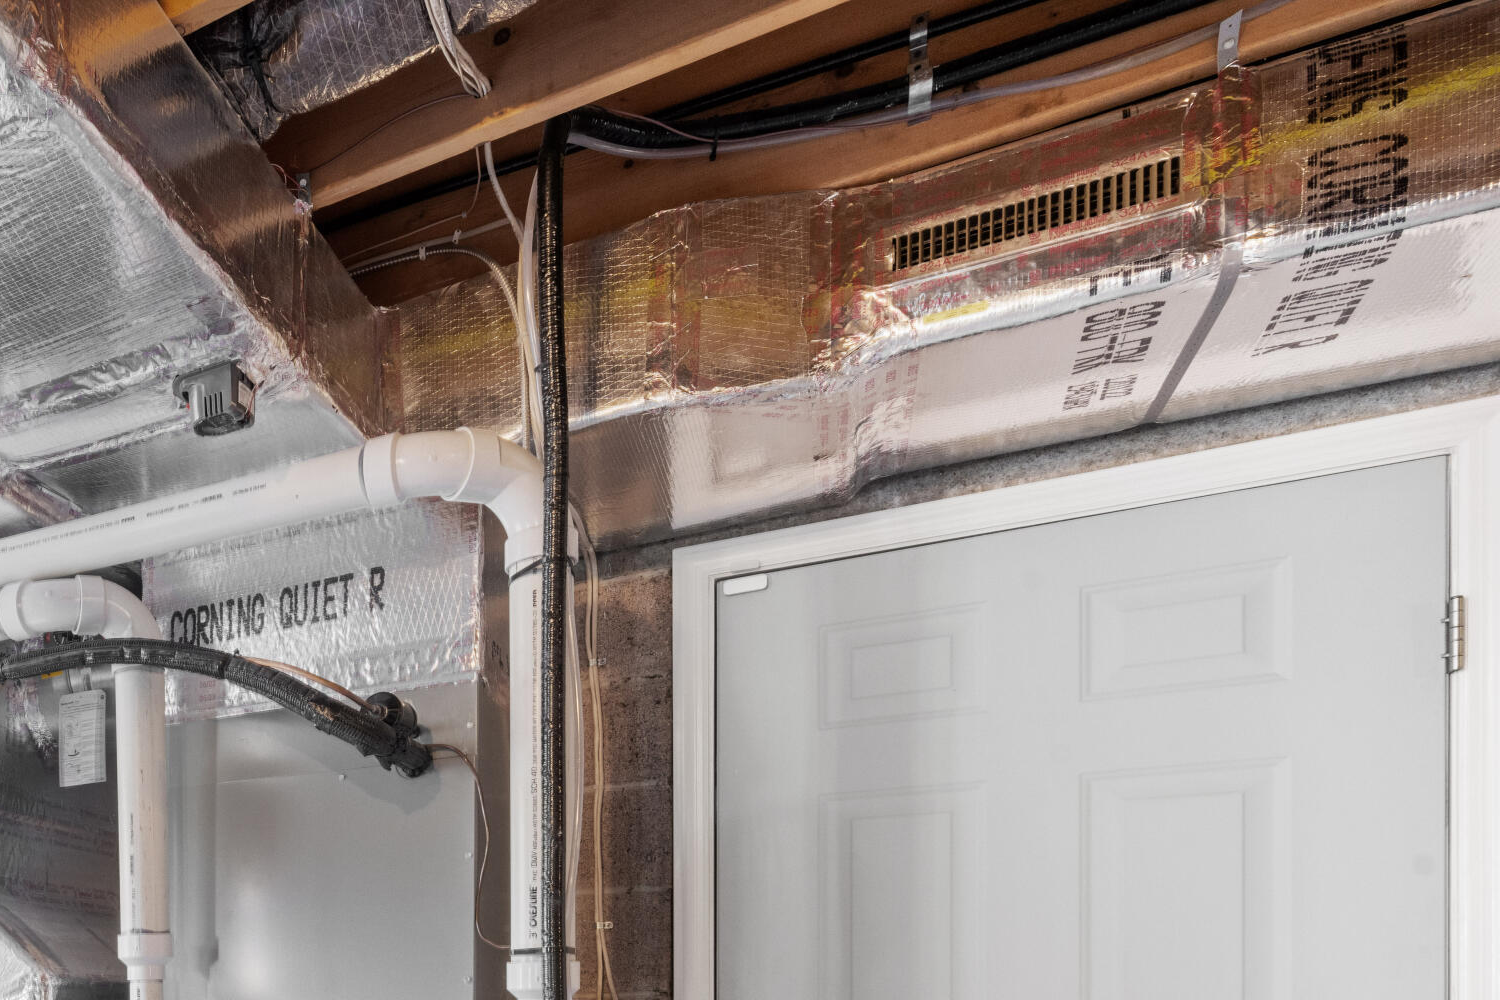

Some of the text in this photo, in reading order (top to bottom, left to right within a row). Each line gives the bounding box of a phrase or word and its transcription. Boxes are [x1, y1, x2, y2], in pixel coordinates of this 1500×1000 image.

[170, 565, 388, 648] CORNING QUIET R
